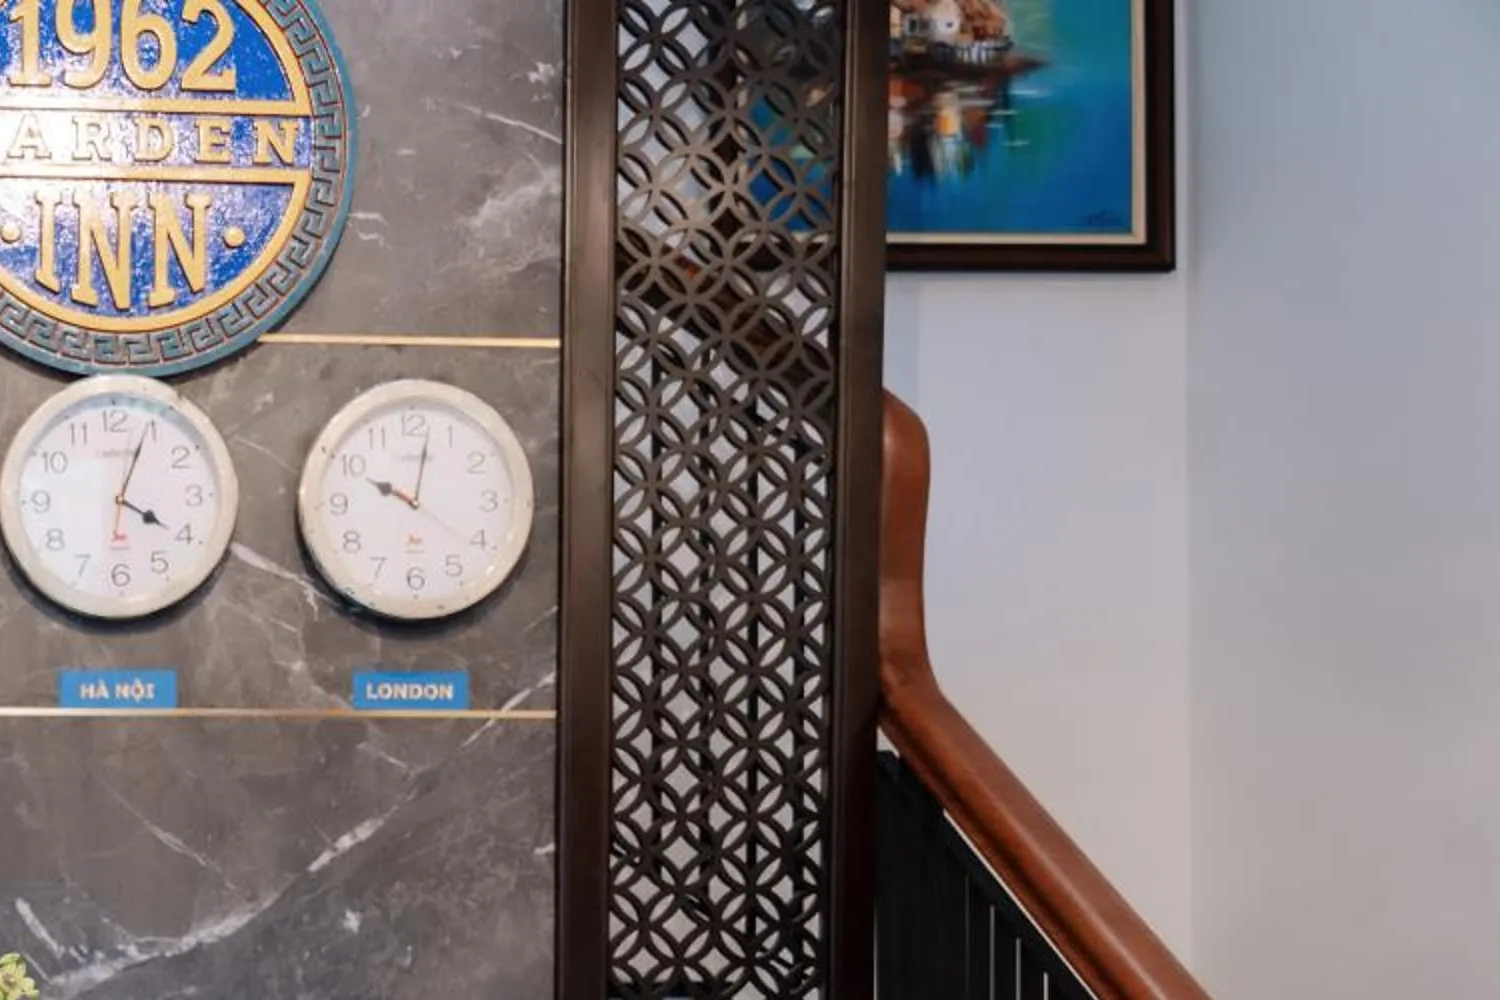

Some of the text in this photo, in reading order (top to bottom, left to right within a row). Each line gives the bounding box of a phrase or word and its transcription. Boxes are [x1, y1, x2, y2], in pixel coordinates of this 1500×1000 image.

[7, 0, 237, 92] 1962
[34, 190, 211, 311] INN
[102, 410, 127, 433] 12
[149, 420, 158, 441] 1
[401, 415, 426, 436] 12
[69, 424, 88, 446] 11
[368, 427, 386, 449] 11
[447, 425, 453, 447] 1
[41, 452, 68, 474] 10
[171, 447, 190, 470] 2
[342, 454, 366, 476] 10
[467, 453, 486, 474] 2
[31, 490, 51, 513] 9
[185, 485, 203, 507] 3
[329, 493, 349, 515] 9
[480, 490, 498, 512] 3
[46, 528, 65, 551] 8
[174, 524, 194, 545] 4
[343, 531, 362, 553] 8
[470, 529, 488, 548] 4
[74, 554, 91, 577] 7
[151, 551, 170, 573] 5
[370, 558, 386, 578] 7
[445, 555, 463, 576] 5
[111, 565, 131, 587] 6
[406, 567, 425, 590] 6
[366, 682, 453, 699] LONDON
